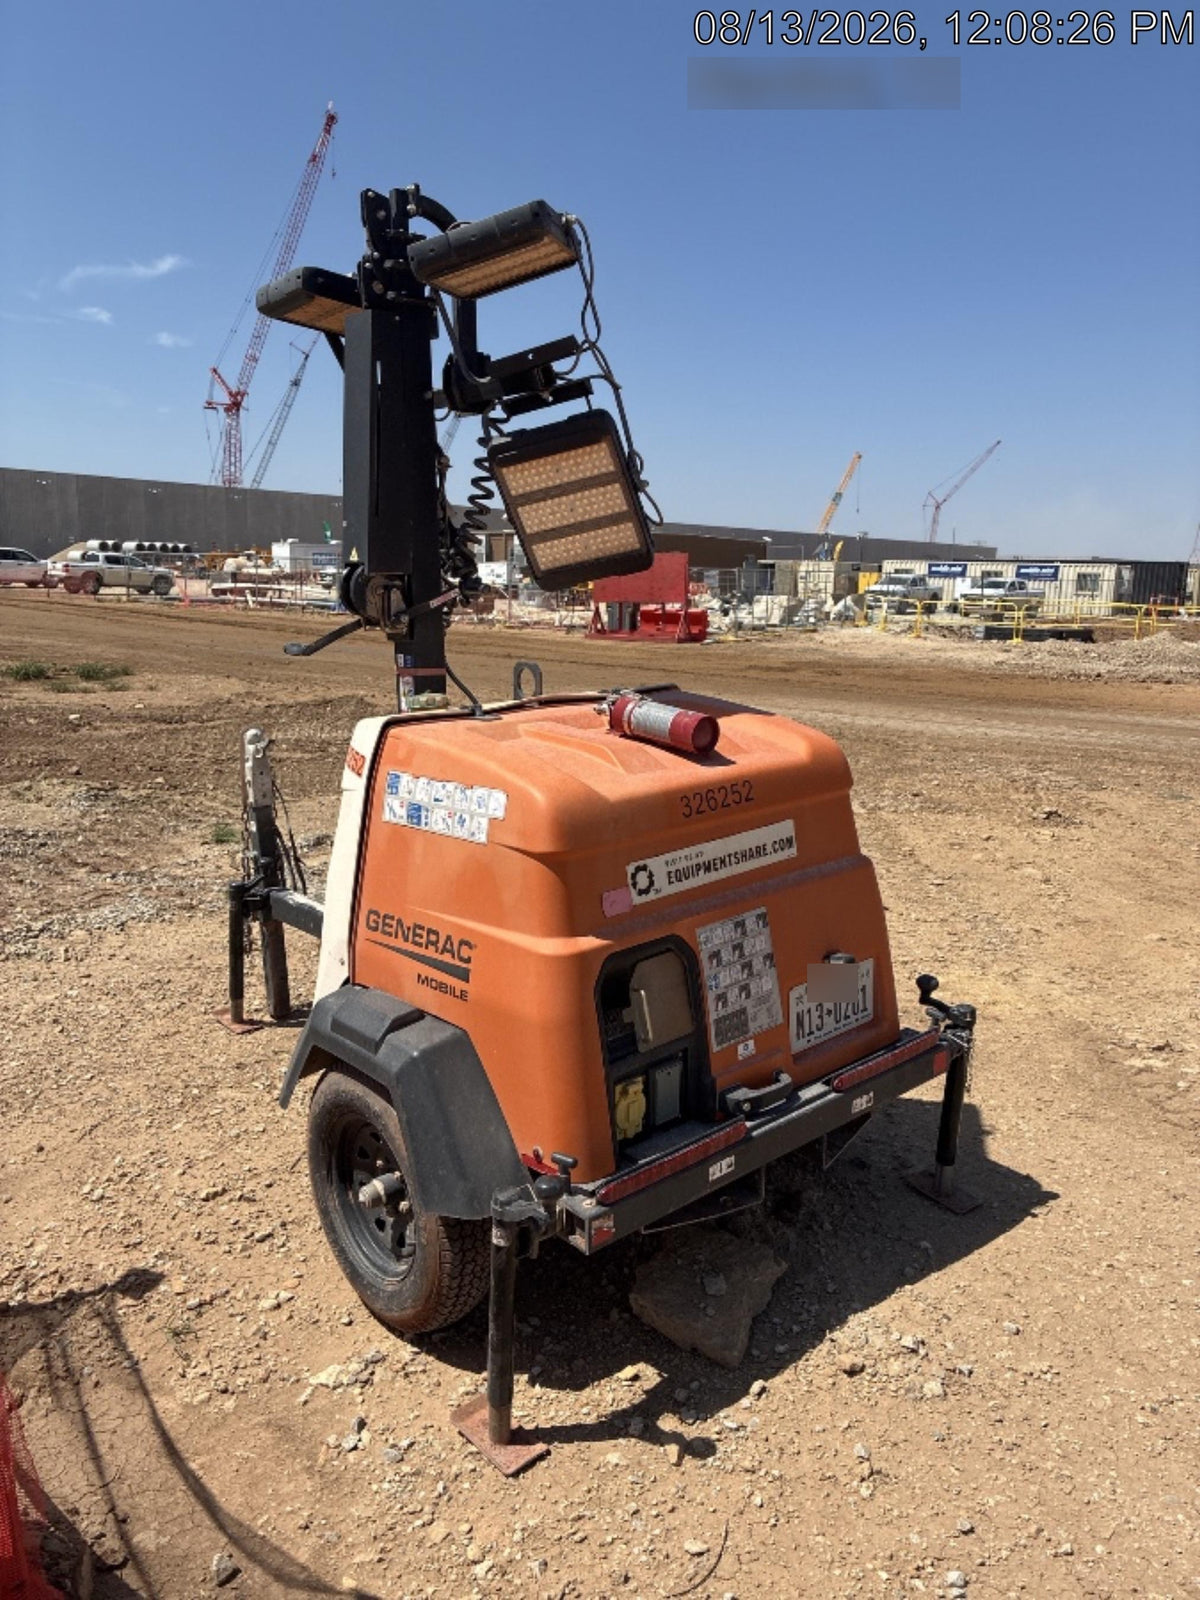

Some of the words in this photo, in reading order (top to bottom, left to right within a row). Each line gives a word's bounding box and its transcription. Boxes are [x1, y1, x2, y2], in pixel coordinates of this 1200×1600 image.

[680, 780, 755, 818] 326252
[667, 835, 794, 885] EQUIPMENTSHARE.COM
[365, 908, 472, 965] GENERAC
[417, 973, 469, 1002] MOBILE
